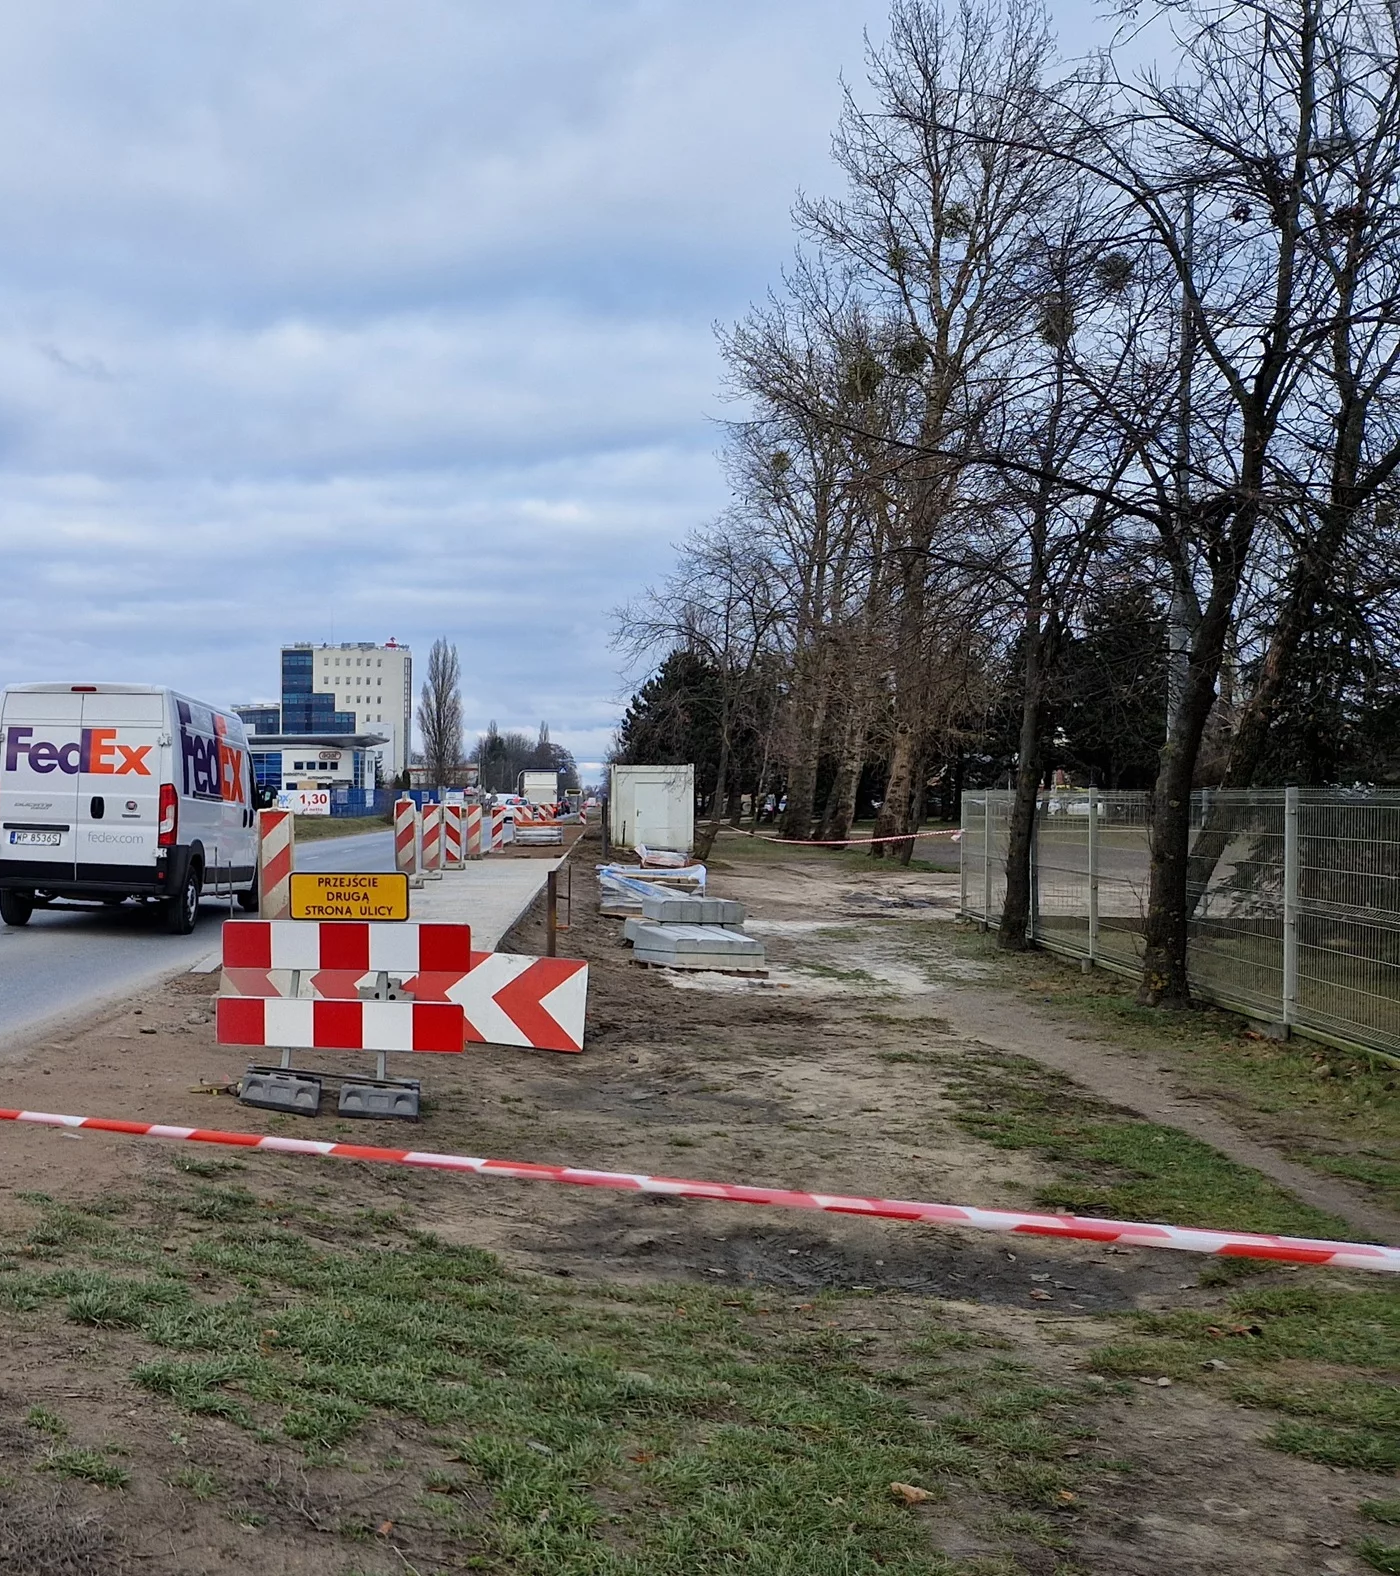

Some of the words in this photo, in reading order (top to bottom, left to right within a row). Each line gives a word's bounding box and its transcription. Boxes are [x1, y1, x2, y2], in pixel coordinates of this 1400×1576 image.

[5, 726, 153, 776] FedEx
[175, 699, 245, 804] FedEx
[300, 793, 327, 806] 1,30
[16, 833, 28, 842] WP
[30, 833, 58, 843] 8536S
[88, 831, 144, 844] fedex.com
[317, 874, 378, 888] PRZEJŚCIE
[326, 891, 370, 904] DRUGĄ
[305, 905, 353, 918] STRONĄ
[360, 906, 393, 916] ULICY
